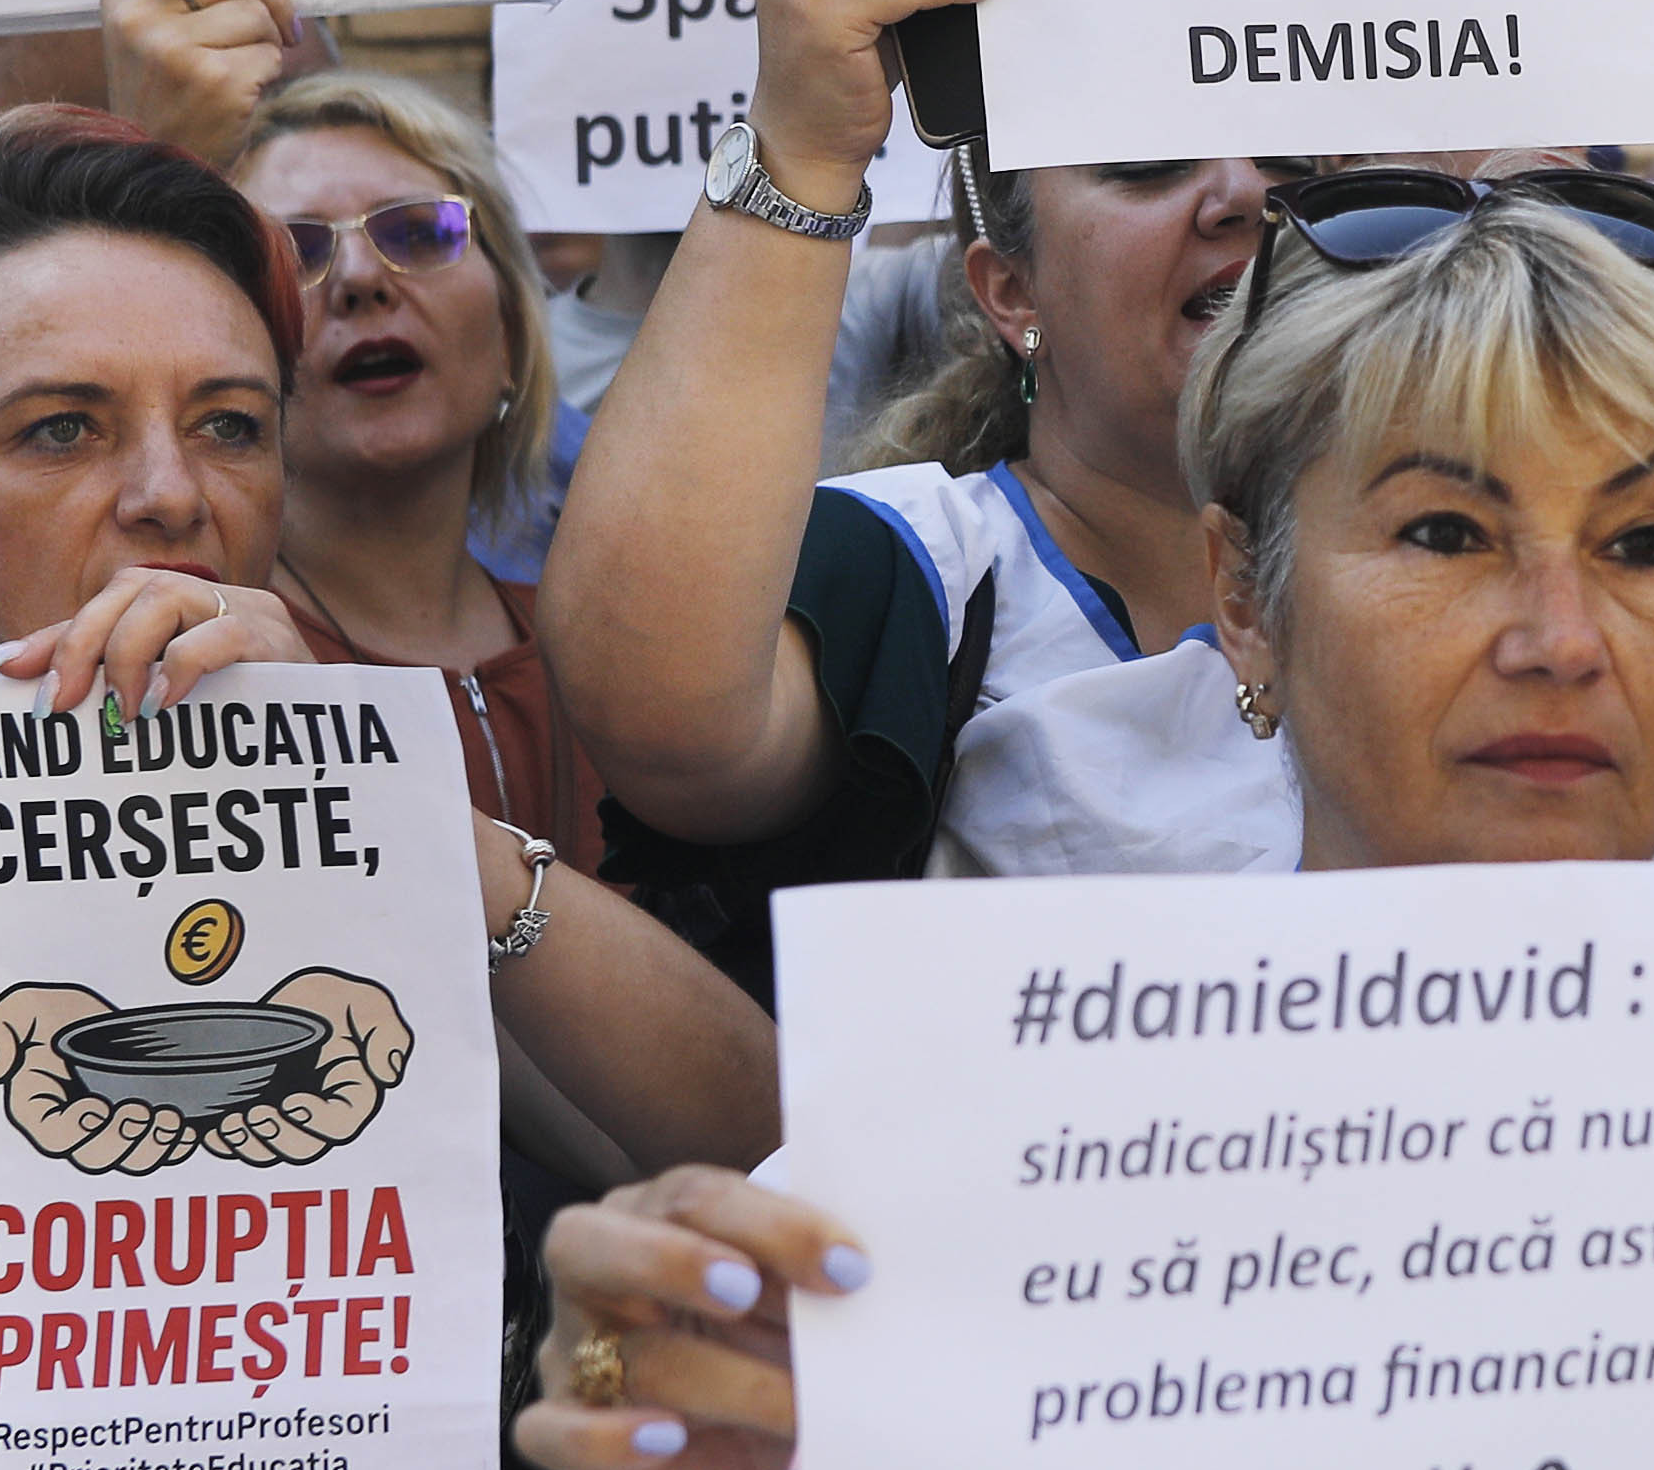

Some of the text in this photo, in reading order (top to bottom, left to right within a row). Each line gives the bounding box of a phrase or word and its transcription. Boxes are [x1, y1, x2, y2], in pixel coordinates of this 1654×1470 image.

[1188, 14, 1522, 84] DEMISIA!
[97, 702, 400, 781] EDUCAȚIA
[1012, 941, 1595, 1046] #danieldavid
[1020, 1107, 1466, 1185] sindicaliștilor
[1488, 1100, 1555, 1157] că
[1580, 1110, 1652, 1150] nu
[1023, 1262, 1101, 1305] eu
[1128, 1241, 1199, 1298] să
[1222, 1233, 1372, 1307] plec,
[1401, 1218, 1555, 1280] dacă
[1031, 1359, 1356, 1441] problema
